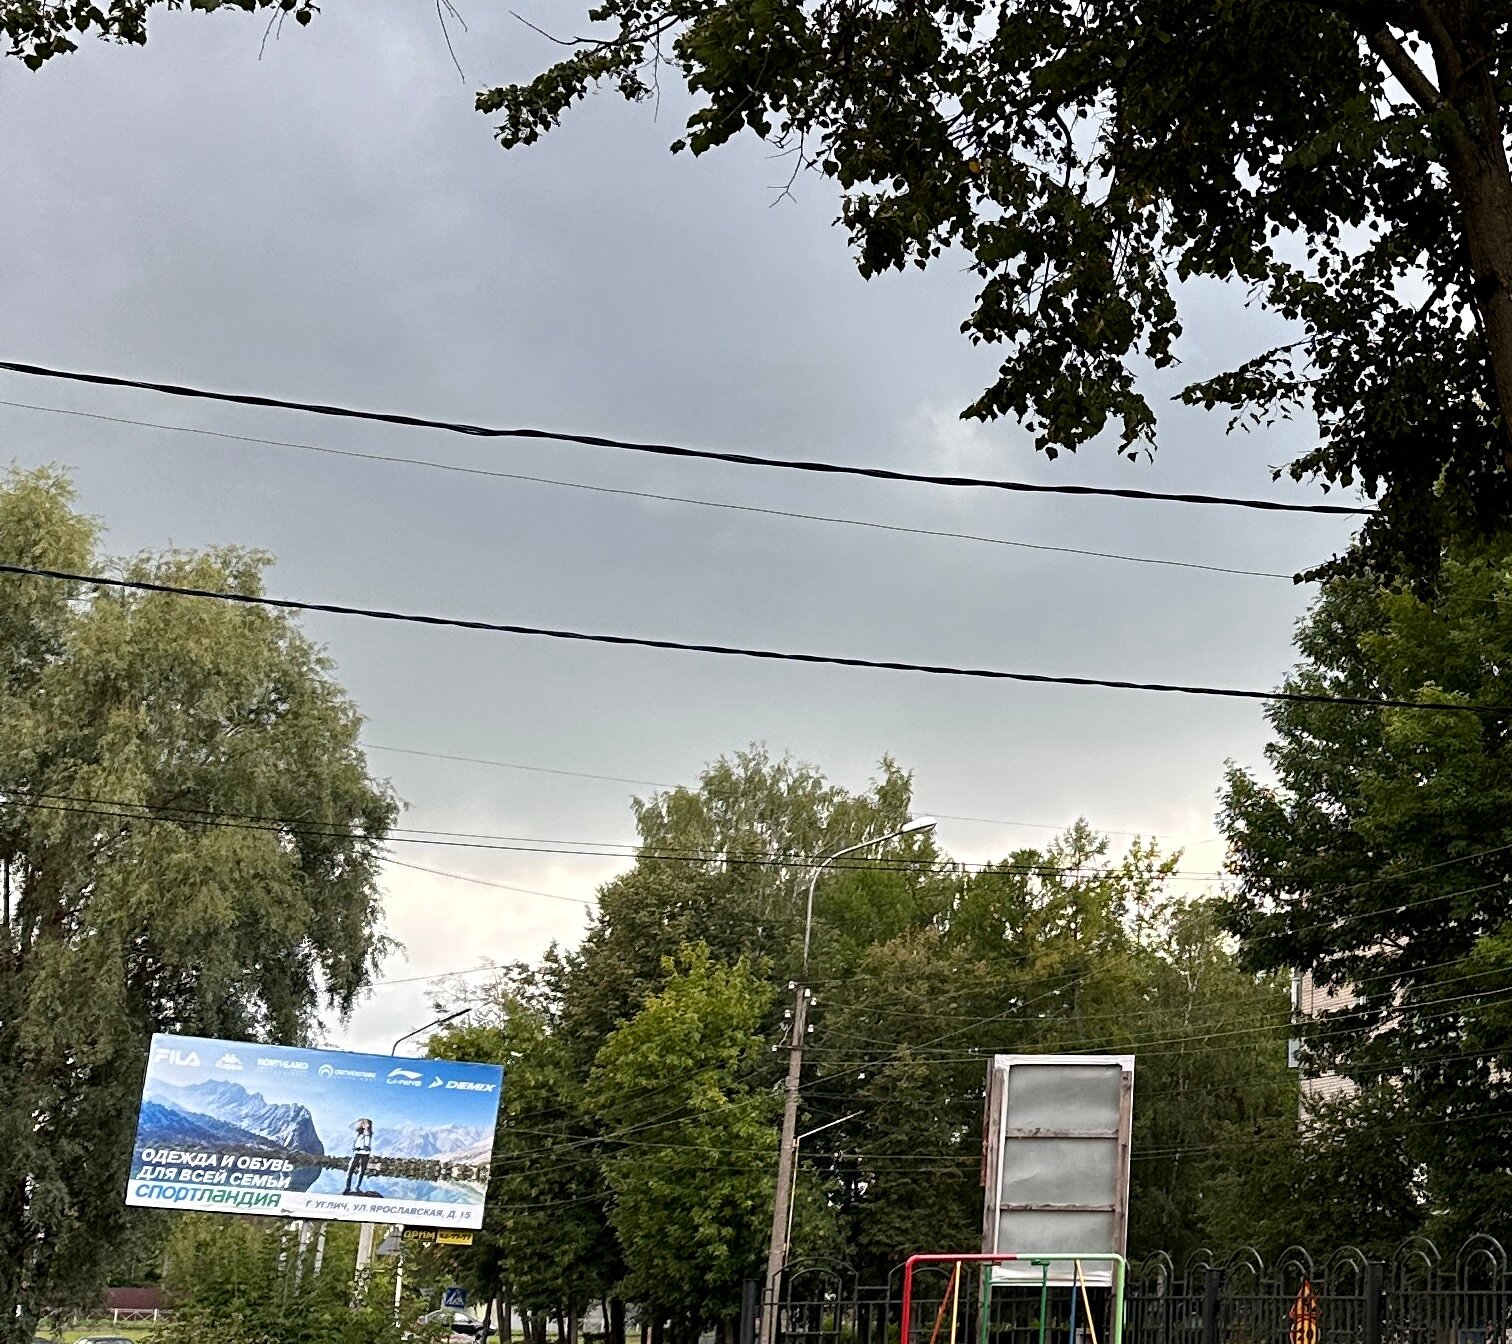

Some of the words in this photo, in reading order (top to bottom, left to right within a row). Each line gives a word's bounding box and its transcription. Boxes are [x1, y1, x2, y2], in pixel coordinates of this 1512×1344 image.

[153, 1048, 201, 1067] FILA
[445, 1080, 496, 1092] DEMIX
[141, 1148, 217, 1167] ОДЕЖДА
[220, 1155, 235, 1168] И
[236, 1156, 294, 1172] ОБУВЬ
[135, 1165, 178, 1180] ДЛЯ
[178, 1168, 228, 1185] ВСЕЙ
[229, 1171, 292, 1189] СЕМЬИ
